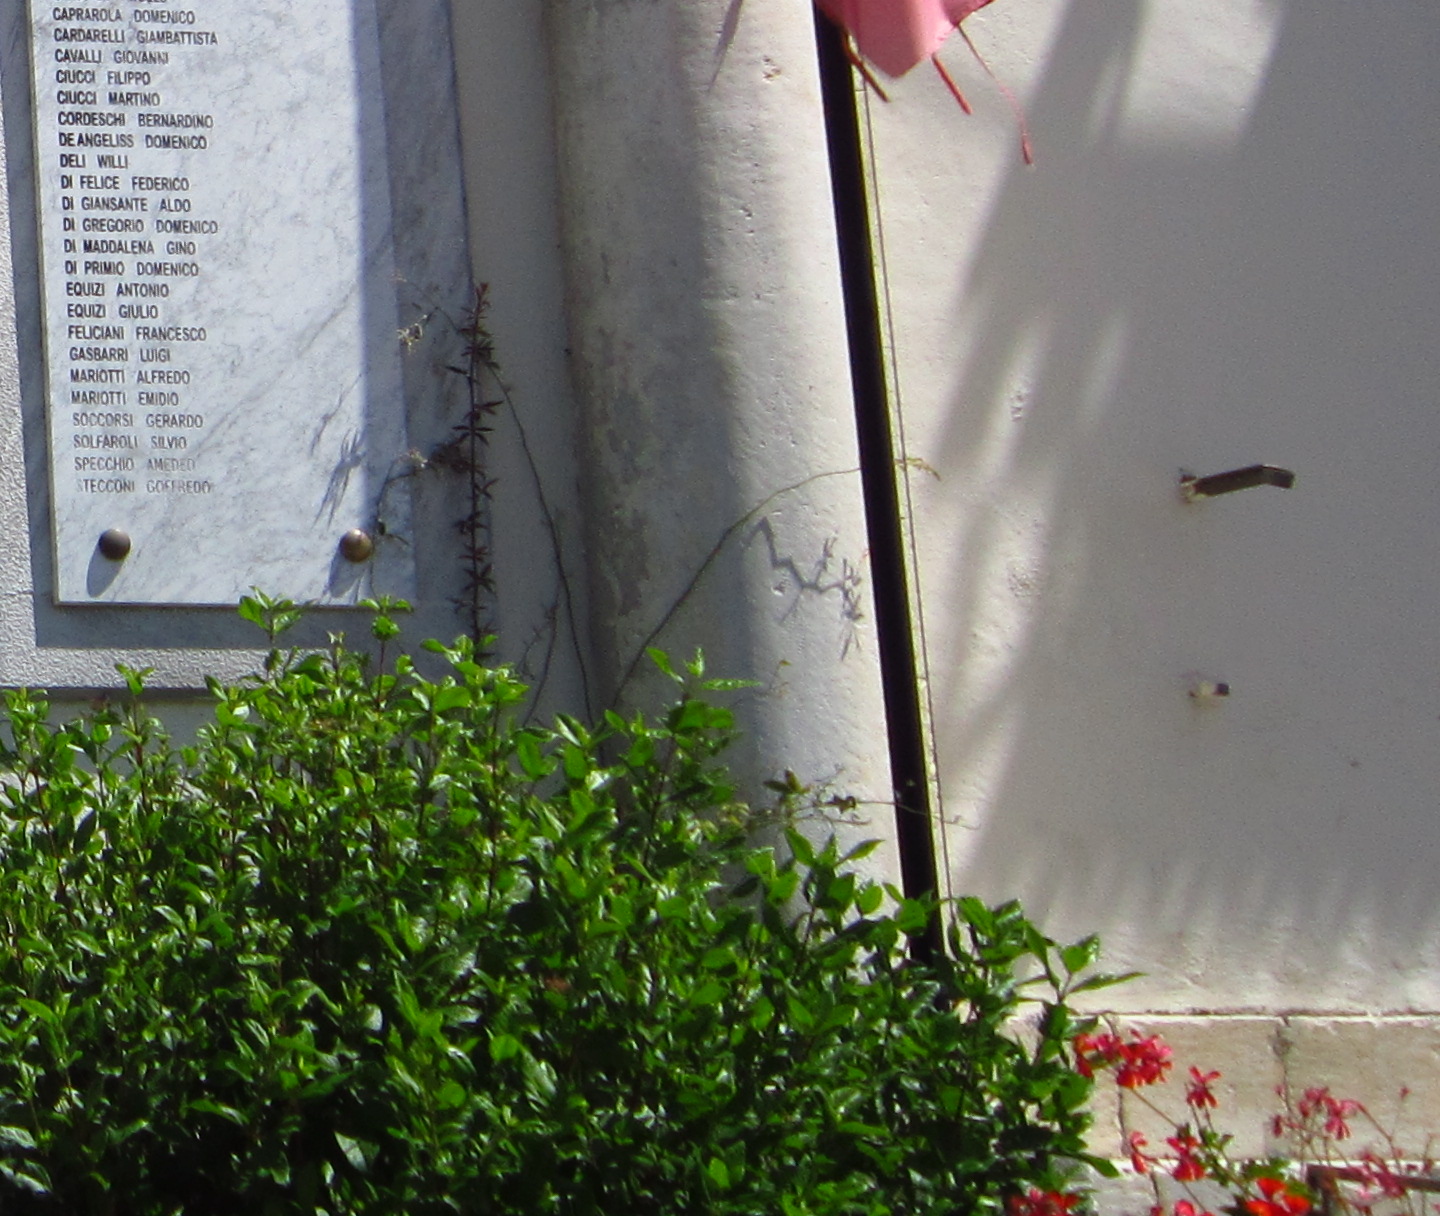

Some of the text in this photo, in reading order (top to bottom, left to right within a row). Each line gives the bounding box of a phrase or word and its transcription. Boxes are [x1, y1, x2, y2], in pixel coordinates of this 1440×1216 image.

[57, 91, 159, 106] CIUCCI MARTINO
[60, 154, 128, 168] DELI WILLI
[66, 283, 169, 298] EQUIZI ANTONIO
[68, 325, 206, 342] FELICIANI FRANCESCO
[71, 369, 189, 385] MARIOTTI ALFREDO
